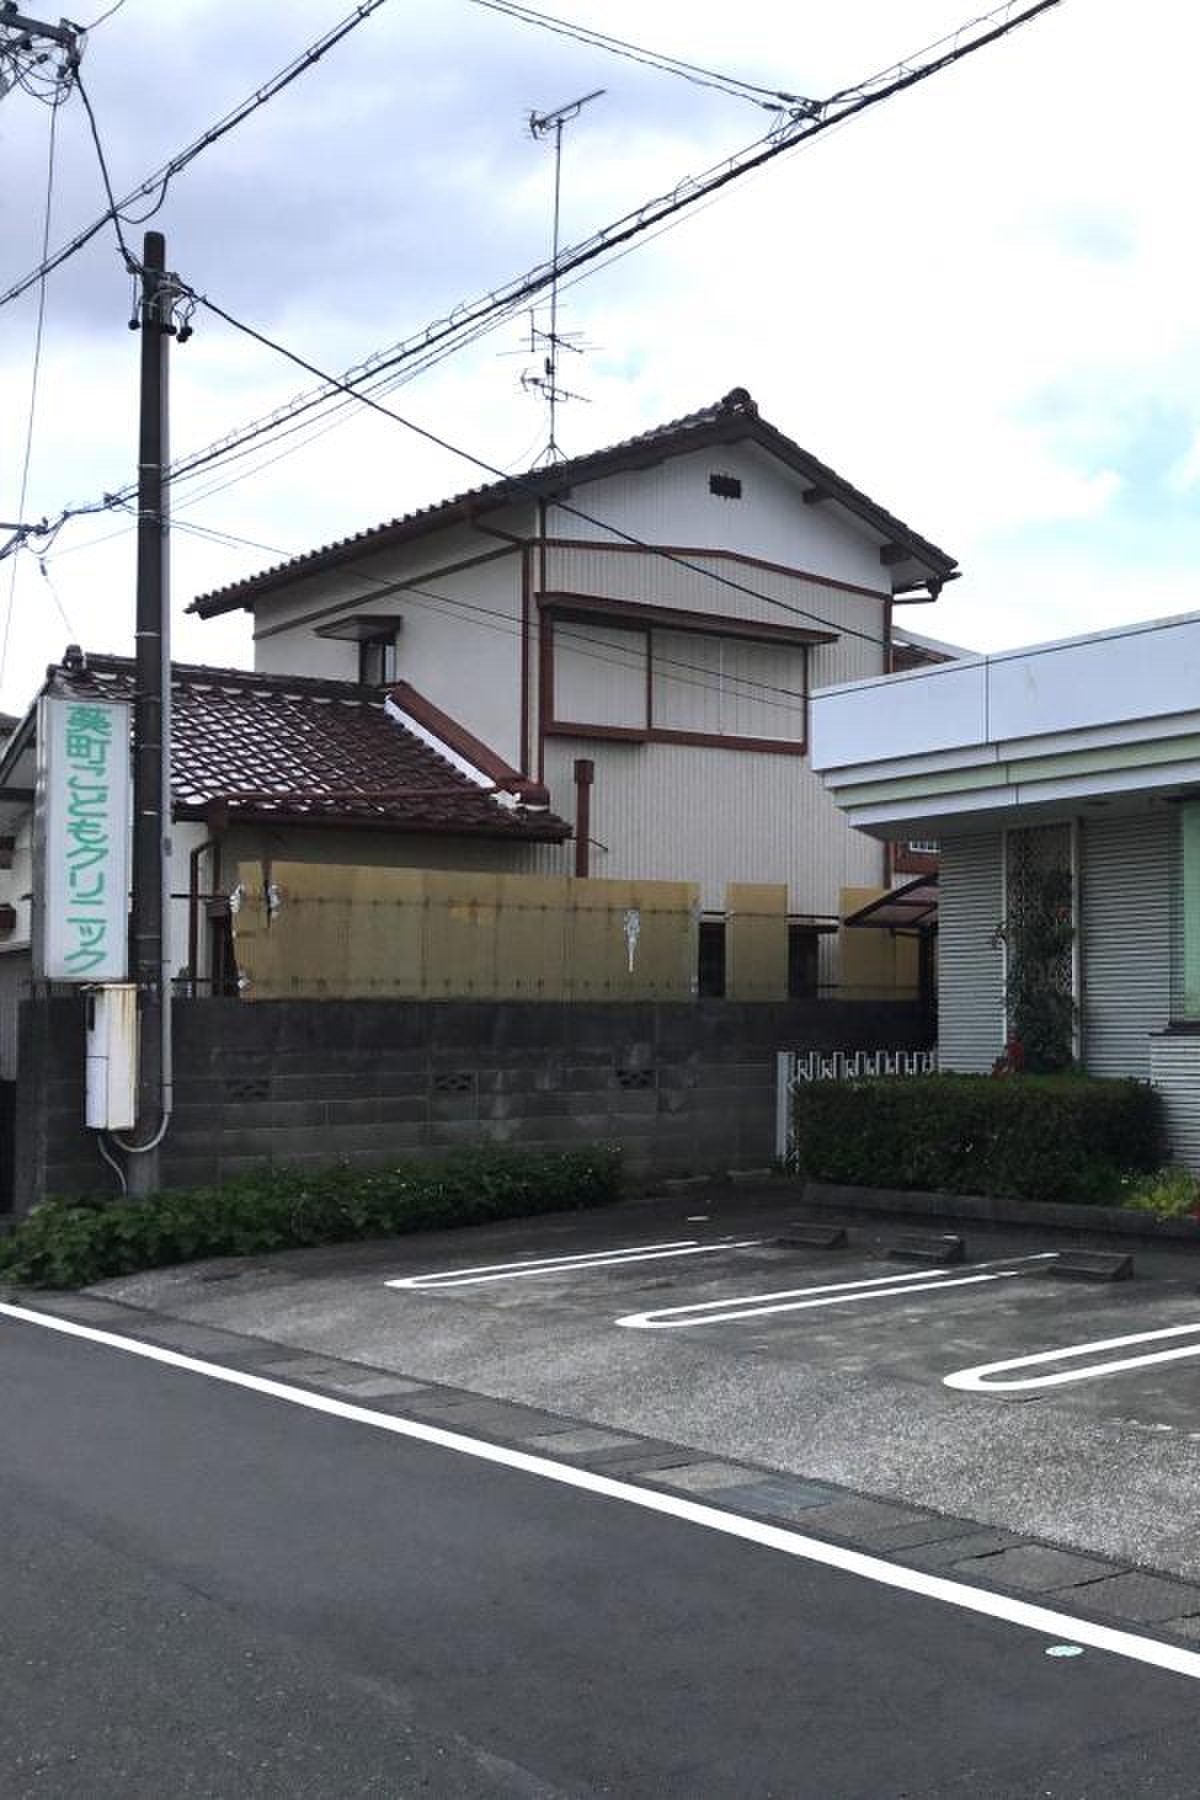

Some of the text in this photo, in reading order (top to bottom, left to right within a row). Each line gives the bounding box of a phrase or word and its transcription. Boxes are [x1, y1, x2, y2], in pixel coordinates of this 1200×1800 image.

[66, 704, 111, 974] 葵町こどもクリニック
